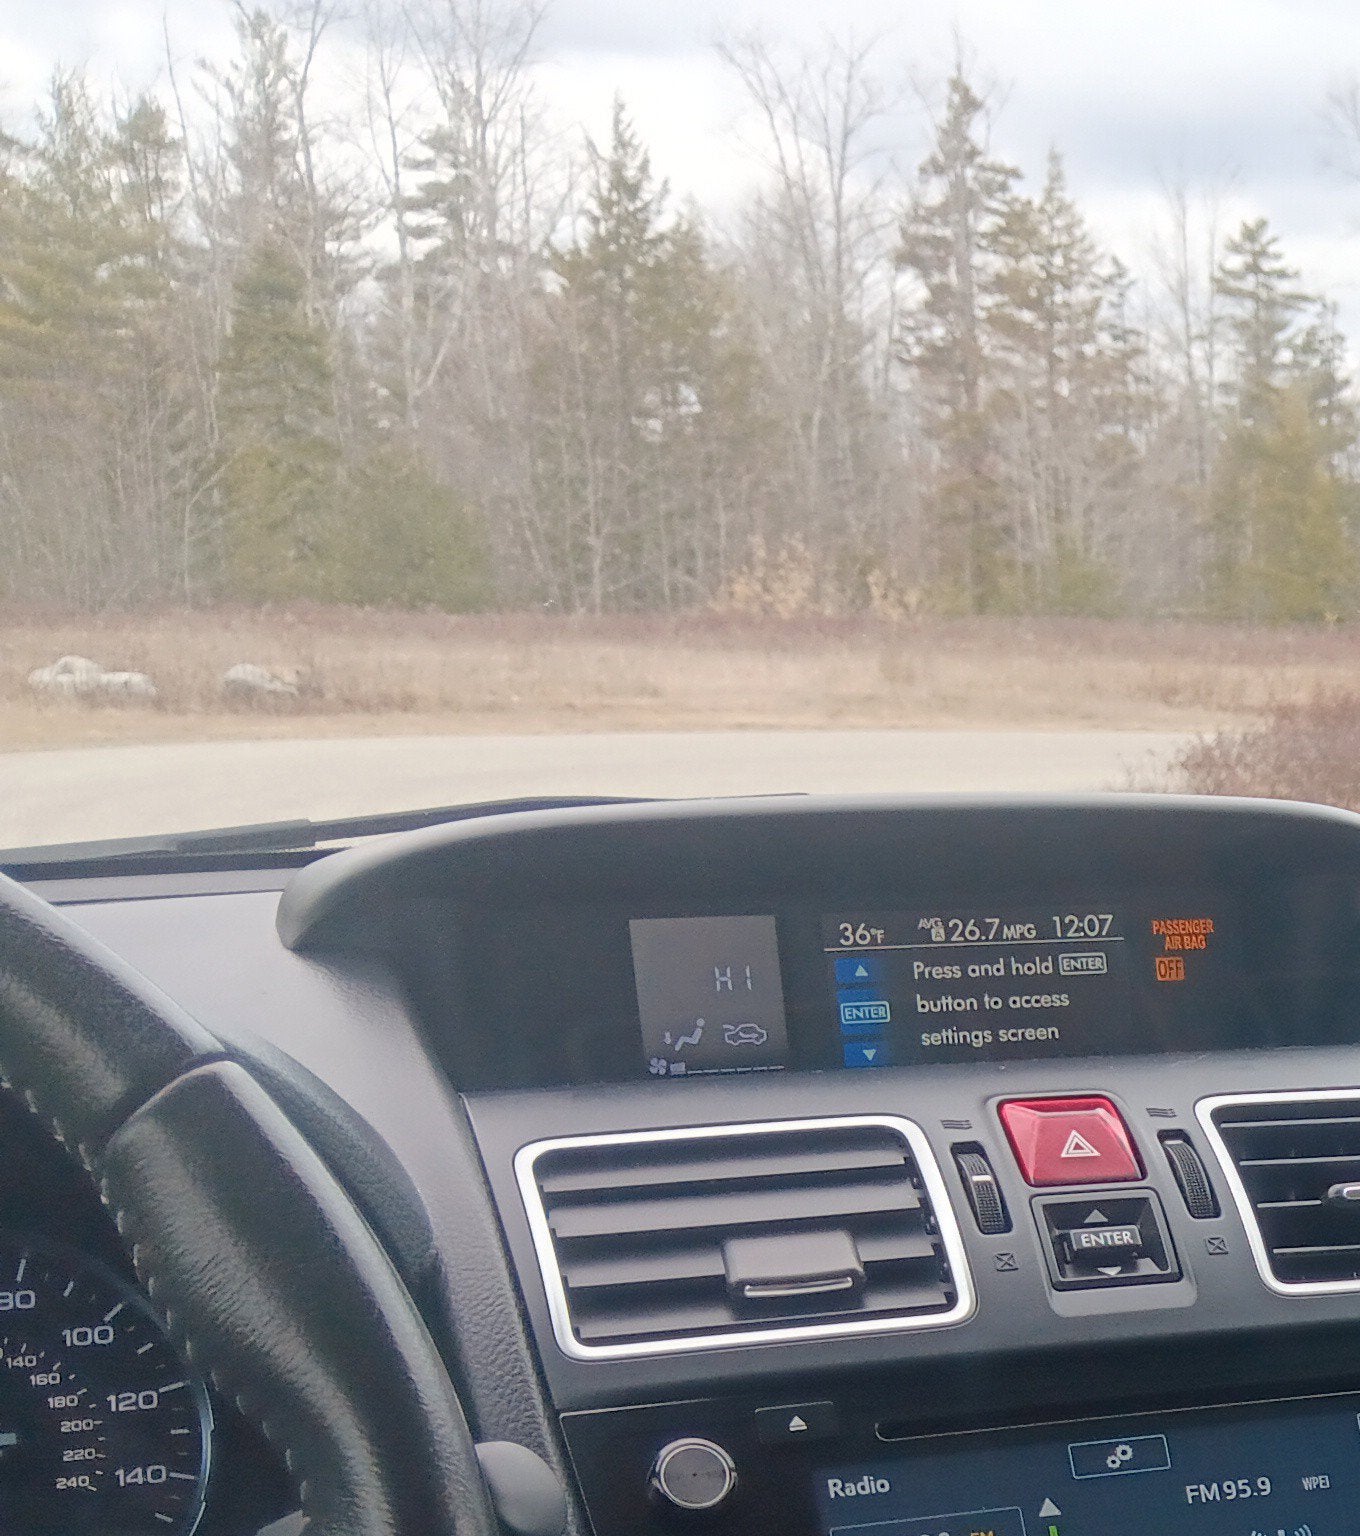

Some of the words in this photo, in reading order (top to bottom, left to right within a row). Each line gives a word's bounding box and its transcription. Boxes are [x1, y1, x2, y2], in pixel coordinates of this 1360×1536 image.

[948, 917, 1001, 942] 26.7
[1003, 923, 1037, 941] MPG
[1052, 914, 1114, 938] 12:07
[1152, 918, 1215, 935] PASSENGER
[913, 961, 962, 979] Press
[967, 957, 1005, 977] and
[1011, 954, 1054, 975] hold
[1062, 957, 1104, 972] ENTER
[1157, 960, 1184, 980] OFF
[916, 993, 978, 1013] button
[983, 990, 1003, 1010] to
[1008, 993, 1071, 1009] access
[843, 1005, 887, 1021] ENTER
[921, 1025, 993, 1048] settings
[998, 1025, 1060, 1043] screen
[1080, 1230, 1134, 1248] ENTER
[62, 1325, 114, 1347] 100
[6, 1355, 37, 1369] 140
[30, 1372, 61, 1387] 160
[47, 1394, 79, 1409] 180
[106, 1389, 158, 1412] 120
[60, 1418, 94, 1433] 200
[62, 1447, 96, 1462] 220
[55, 1475, 90, 1490] 240
[115, 1464, 167, 1487] 140
[827, 1475, 890, 1499] Radio
